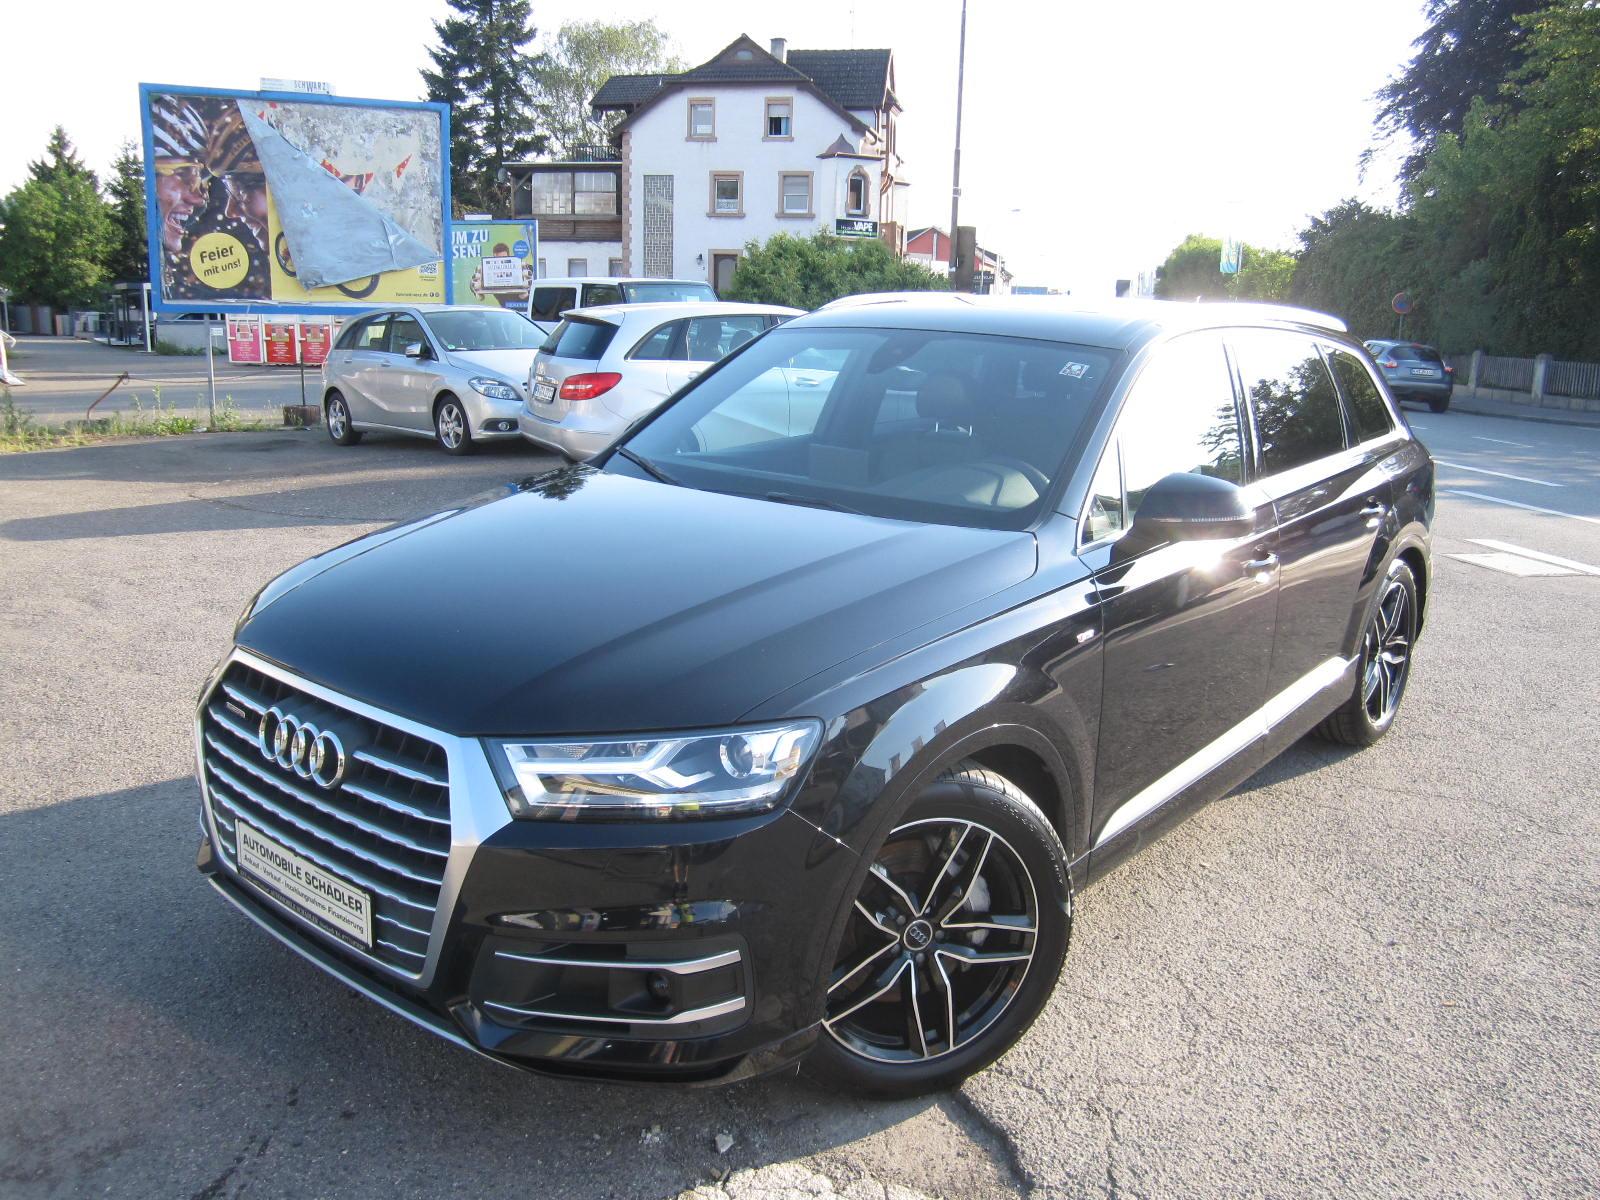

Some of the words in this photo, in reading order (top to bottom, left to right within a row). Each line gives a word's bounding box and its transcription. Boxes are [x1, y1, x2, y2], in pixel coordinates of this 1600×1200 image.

[294, 80, 326, 92] SCHWARZ
[471, 229, 489, 243] ZU
[854, 221, 873, 232] VAPE
[200, 245, 234, 264] Feier
[203, 266, 220, 277] mit
[221, 258, 241, 272] uns!
[243, 833, 302, 881] AUTOMOBILE
[304, 871, 363, 915] SCHÄDLER
[327, 905, 364, 935] Finanzierung
